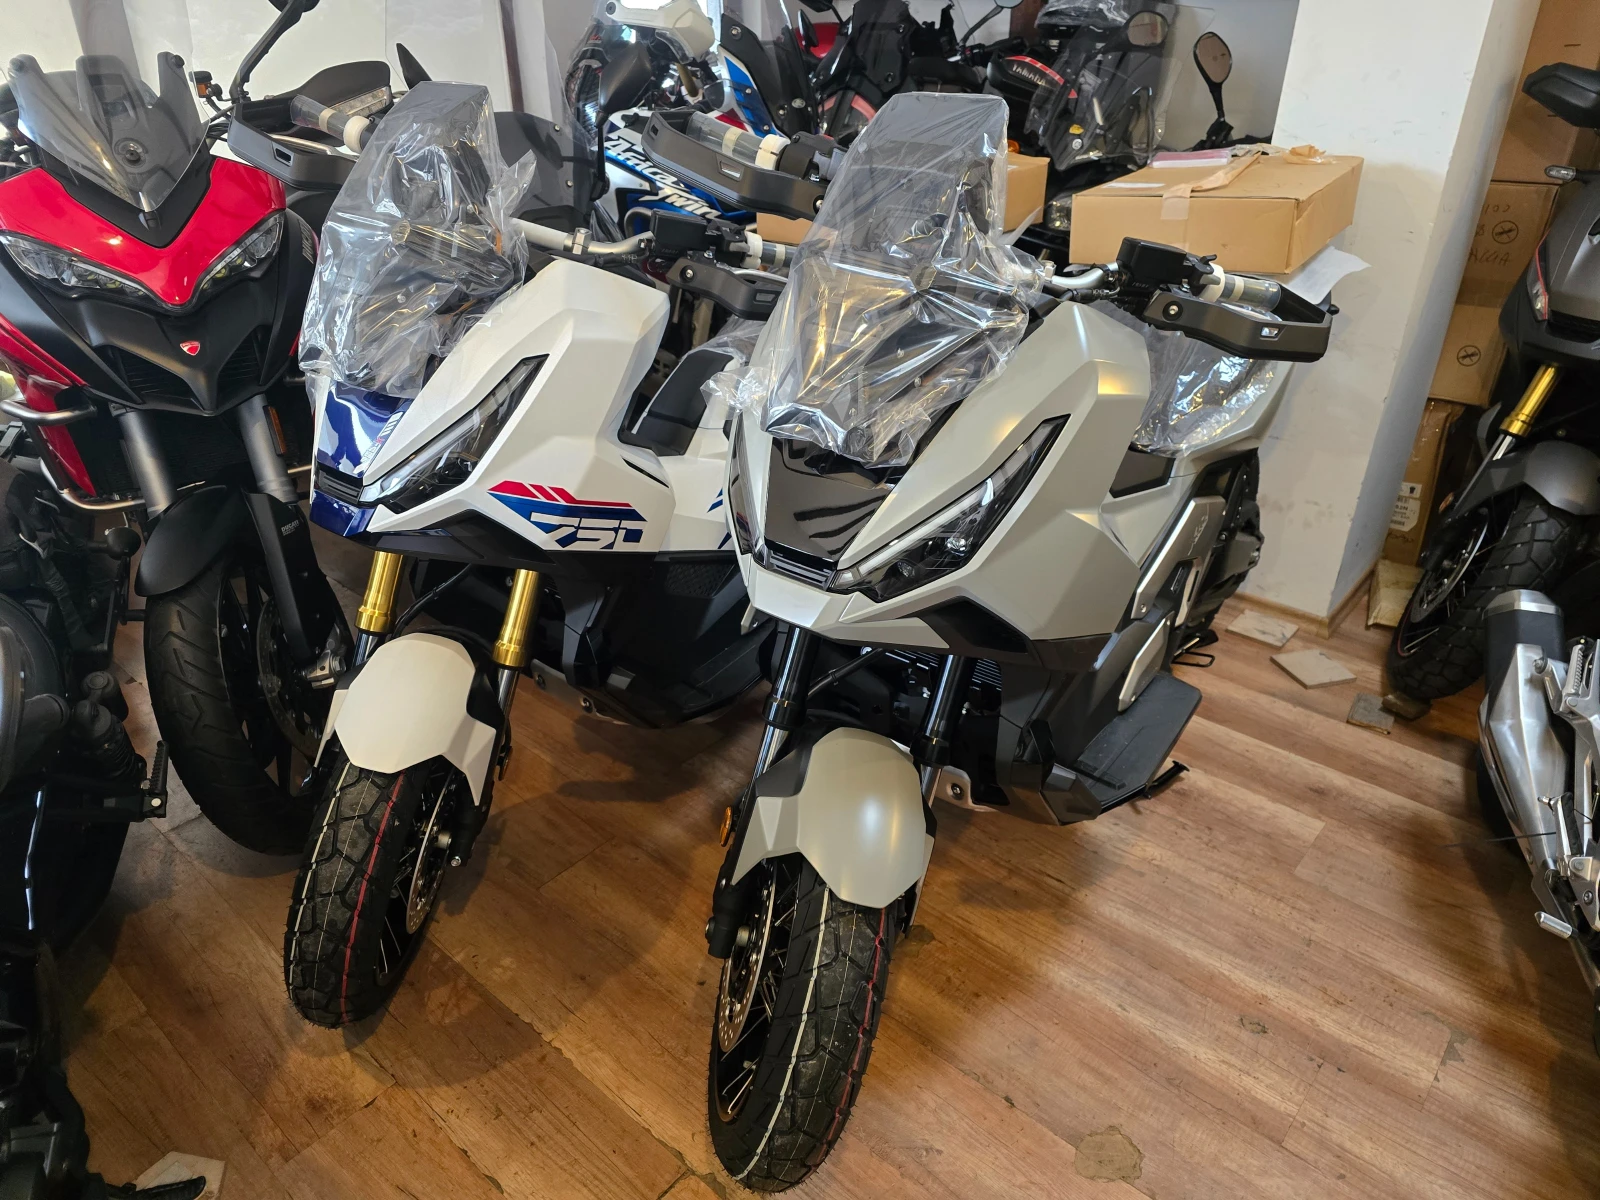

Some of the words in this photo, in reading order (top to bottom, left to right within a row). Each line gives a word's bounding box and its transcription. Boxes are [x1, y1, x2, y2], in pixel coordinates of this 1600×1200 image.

[602, 138, 688, 188] Africa
[638, 184, 722, 220] Twin
[530, 511, 648, 551] 750
